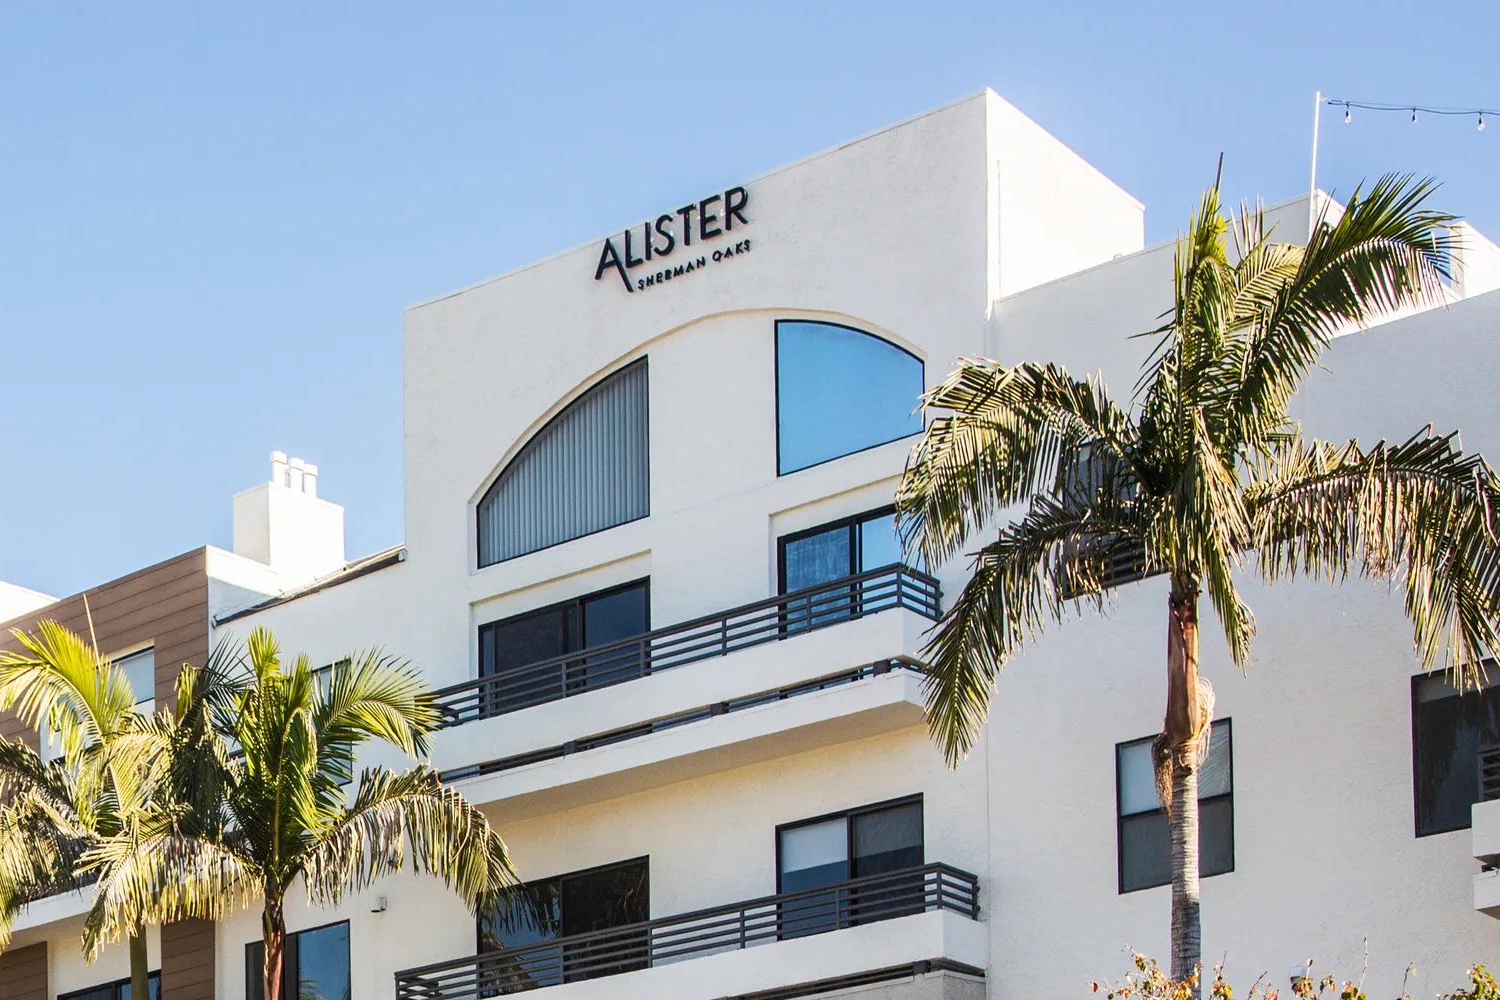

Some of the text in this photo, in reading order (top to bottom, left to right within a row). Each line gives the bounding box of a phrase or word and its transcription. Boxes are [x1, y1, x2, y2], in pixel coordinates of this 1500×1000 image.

[595, 186, 749, 292] ALISTER
[637, 239, 751, 290] SHERMAN OAKS
